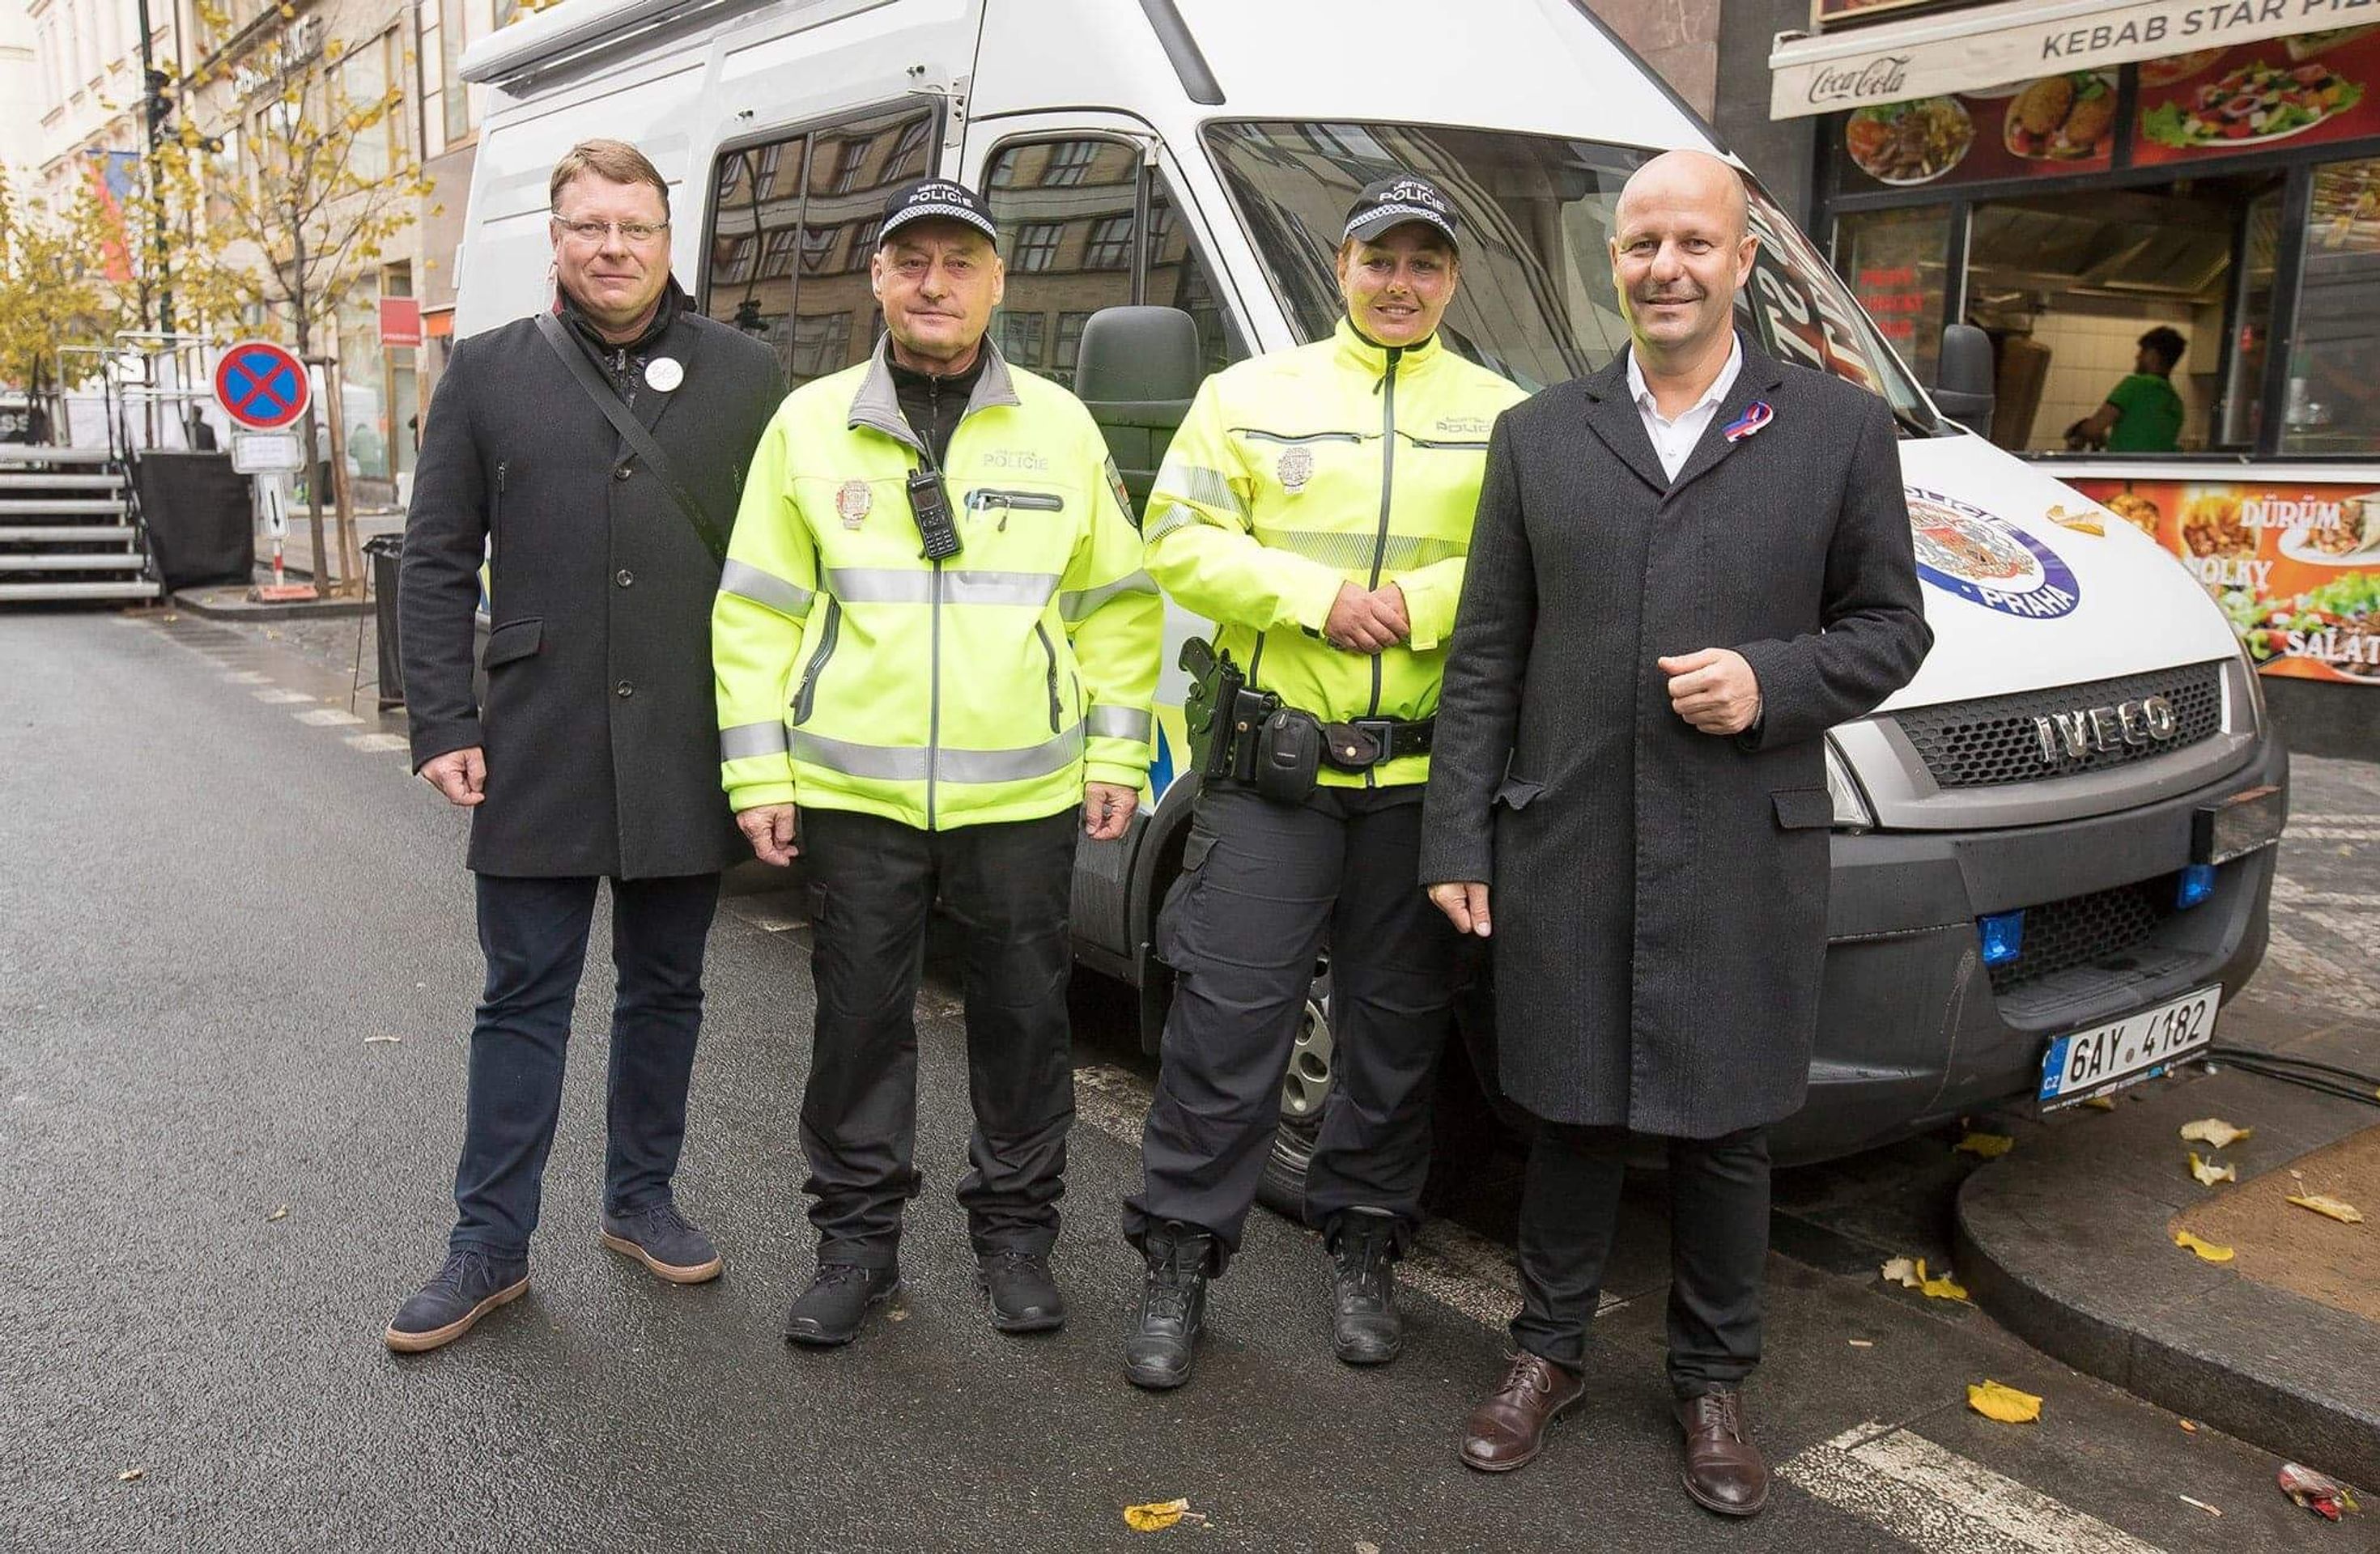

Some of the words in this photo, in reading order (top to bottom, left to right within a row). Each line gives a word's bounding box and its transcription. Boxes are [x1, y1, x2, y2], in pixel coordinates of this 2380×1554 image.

[2042, 15, 2168, 60] KEBAB
[2180, 0, 2285, 36] STAR
[907, 190, 973, 208] POLICIE
[1379, 188, 1447, 213] POLICIE
[1436, 421, 1491, 435] POLIC
[983, 453, 1049, 470] POLICIE
[1902, 484, 2012, 531] OLICIE
[2239, 493, 2341, 531] DÜRÜM
[1977, 583, 2076, 616] PRAHA
[2034, 694, 2178, 763] IVECO
[2070, 1025, 2124, 1083] 6AY
[2142, 999, 2206, 1057] 4182
[2042, 1075, 2059, 1090] CZ
